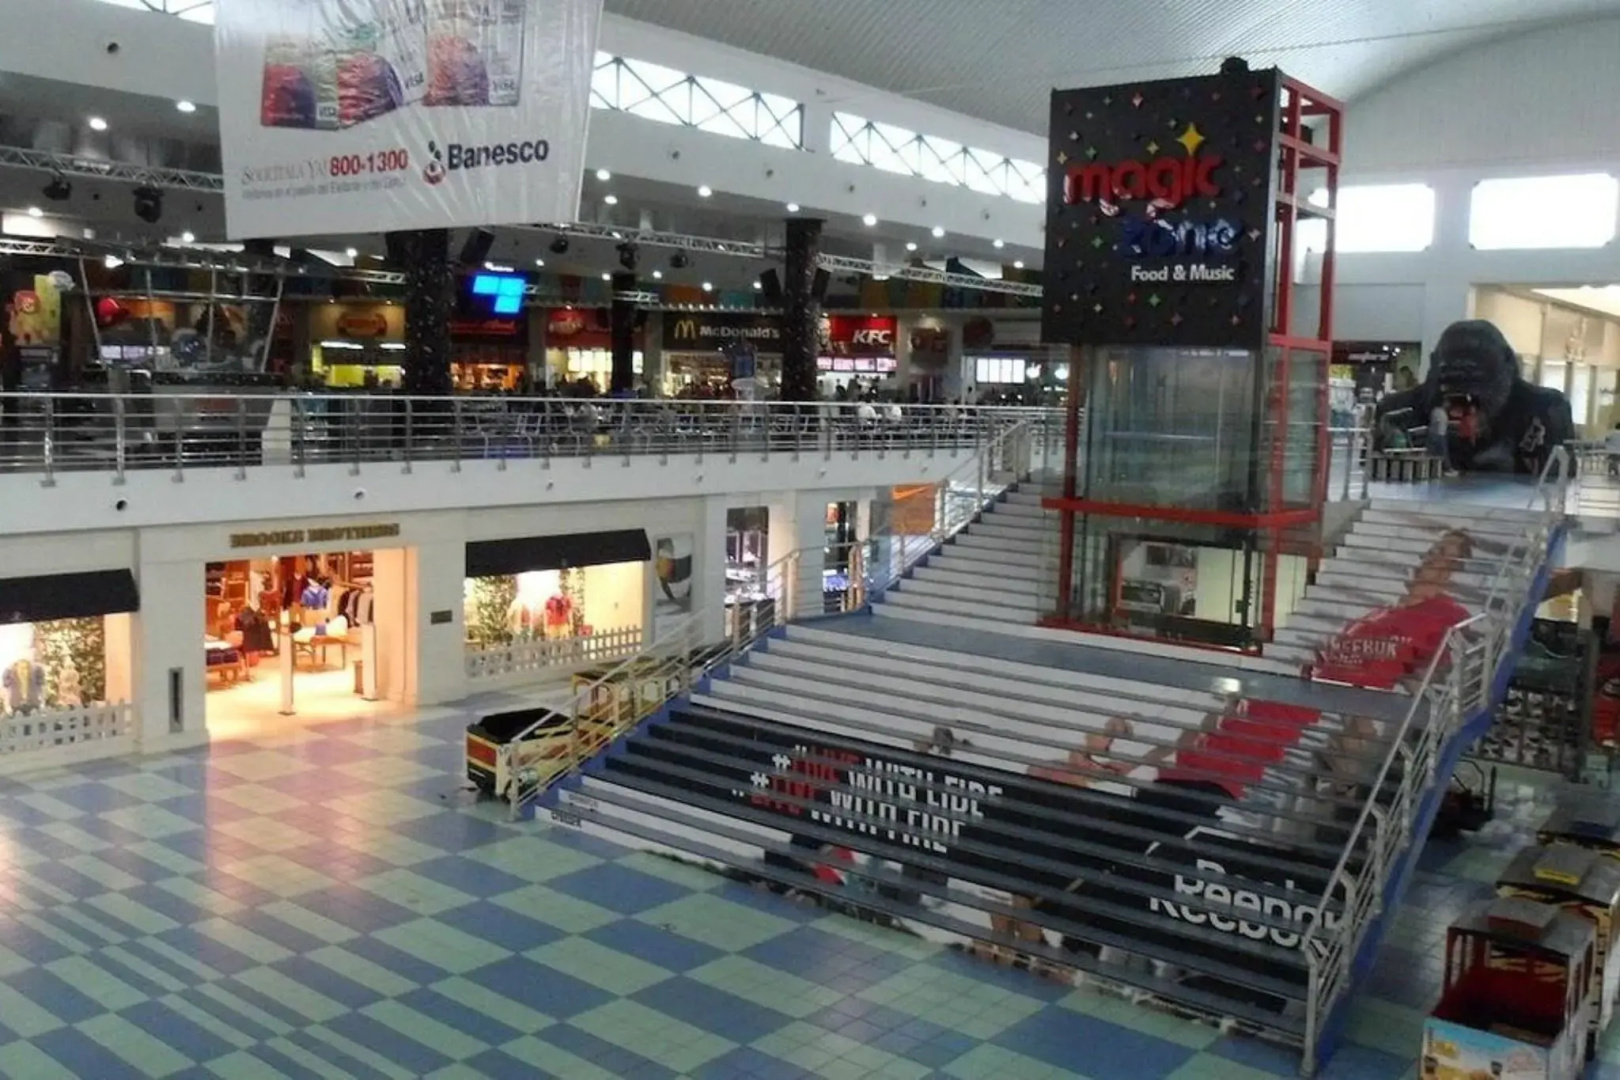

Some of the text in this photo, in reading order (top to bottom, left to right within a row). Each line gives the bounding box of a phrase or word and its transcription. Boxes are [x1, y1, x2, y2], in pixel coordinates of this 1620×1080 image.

[329, 149, 408, 177] 800-1300
[447, 139, 549, 171] Banesco
[1063, 153, 1222, 217] magic
[1131, 264, 1235, 281] Food & Music
[700, 326, 780, 339] McDonald's
[853, 329, 892, 344] KFC
